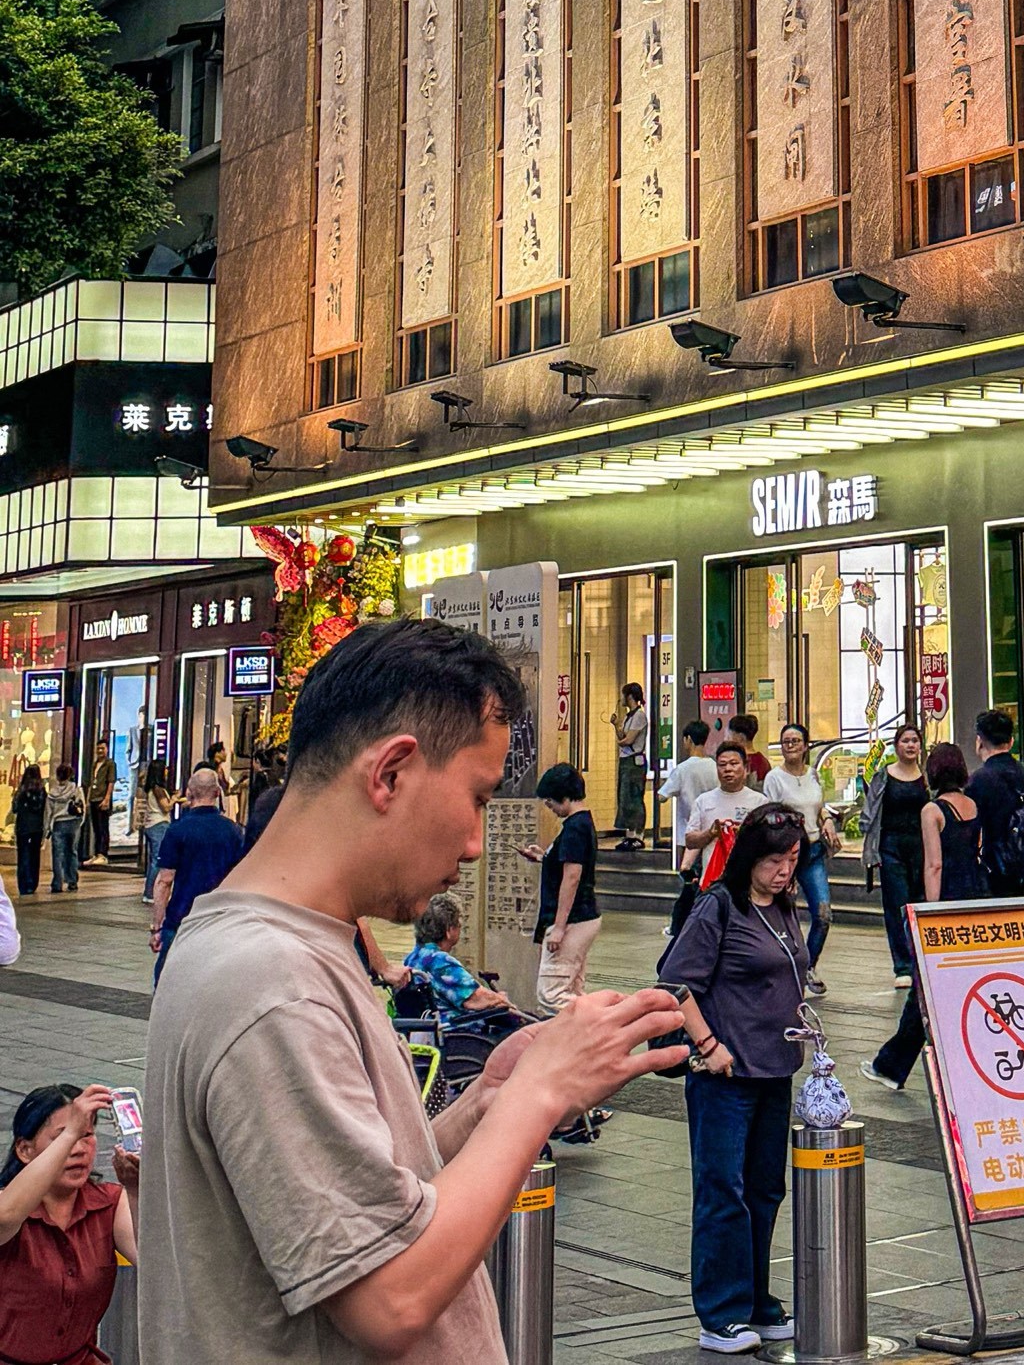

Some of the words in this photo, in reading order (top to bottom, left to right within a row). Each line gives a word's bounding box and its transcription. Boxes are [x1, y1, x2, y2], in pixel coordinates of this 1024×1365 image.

[752, 470, 822, 537] SEMIR
[191, 597, 252, 629] 莱克斯顿
[662, 652, 671, 665] 3F
[662, 694, 671, 707] 2F
